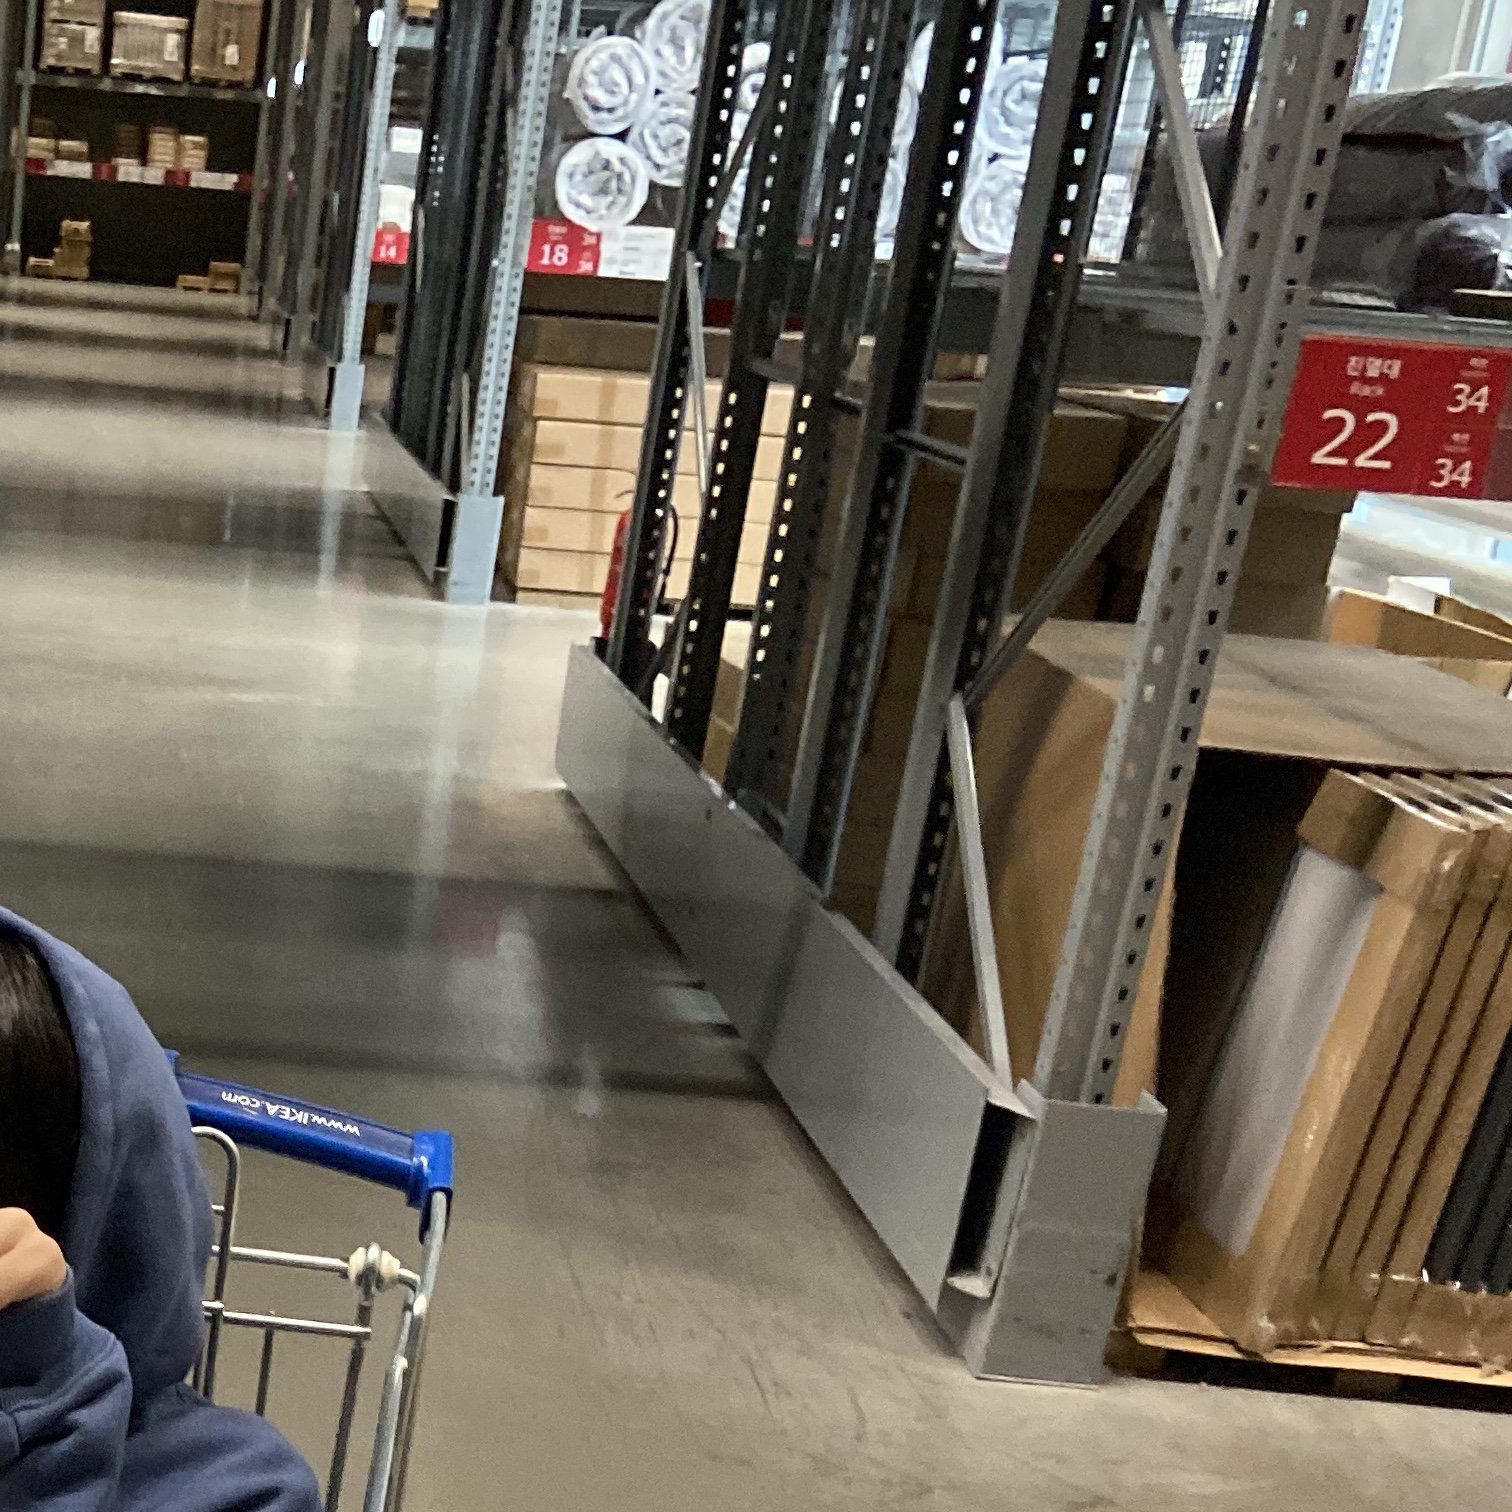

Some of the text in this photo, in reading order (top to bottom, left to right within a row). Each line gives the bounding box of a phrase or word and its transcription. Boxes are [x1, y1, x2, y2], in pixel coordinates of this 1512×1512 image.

[541, 243, 569, 266] 18
[1446, 383, 1489, 414] 34
[1310, 407, 1399, 470] 22
[1429, 457, 1473, 489] 34
[221, 1090, 361, 1137] www.IKEA.com
